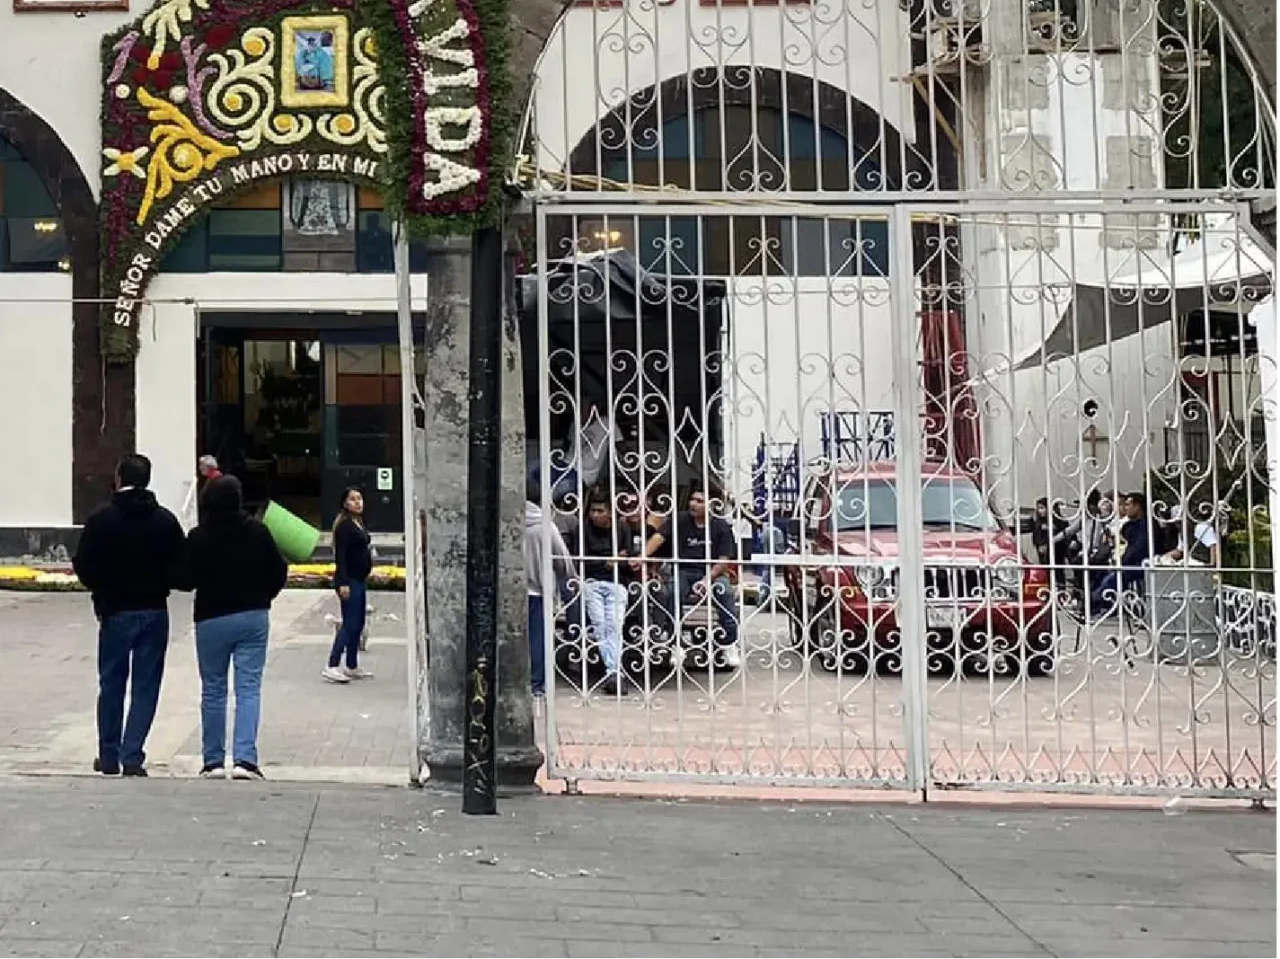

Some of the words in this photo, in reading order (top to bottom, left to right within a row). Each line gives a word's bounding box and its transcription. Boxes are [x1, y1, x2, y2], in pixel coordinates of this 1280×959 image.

[417, 19, 483, 201] VIDA
[115, 252, 152, 327] SEÑOR
[145, 195, 196, 251] DAME
[193, 176, 224, 201] TU
[230, 153, 293, 185] MANO
[293, 153, 310, 171] Y
[316, 153, 348, 172] EN
[352, 155, 380, 178] MI
